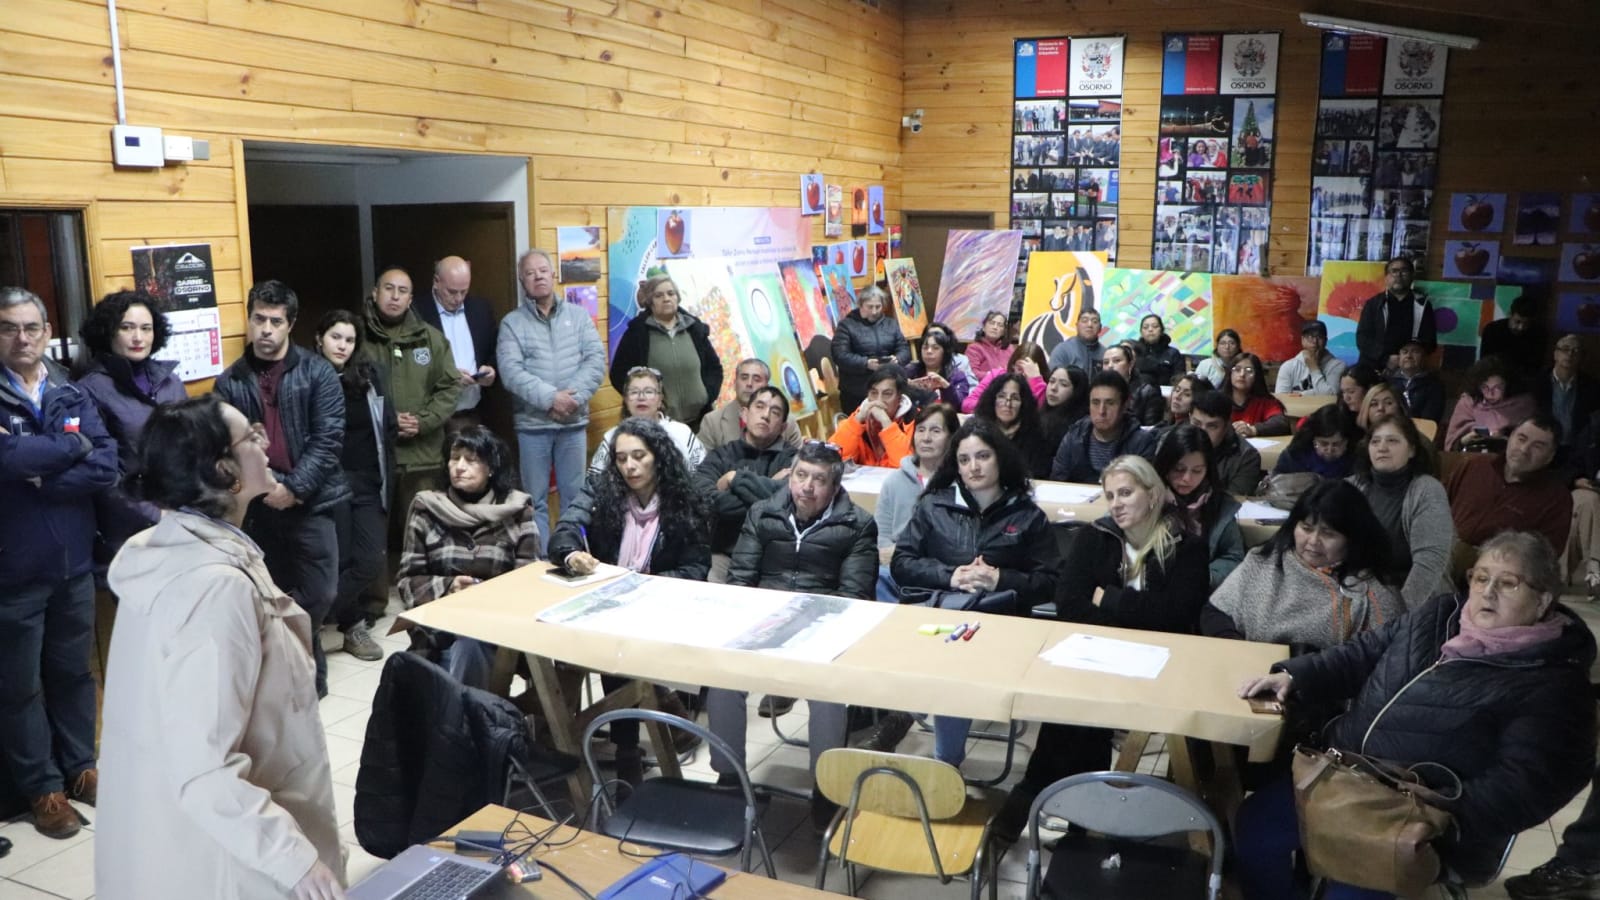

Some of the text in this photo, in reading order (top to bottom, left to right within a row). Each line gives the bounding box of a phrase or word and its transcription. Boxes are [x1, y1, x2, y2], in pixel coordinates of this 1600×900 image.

[1079, 83, 1112, 91] OSORNO
[1394, 82, 1433, 90] OSORNO
[175, 285, 210, 294] OSORNO
